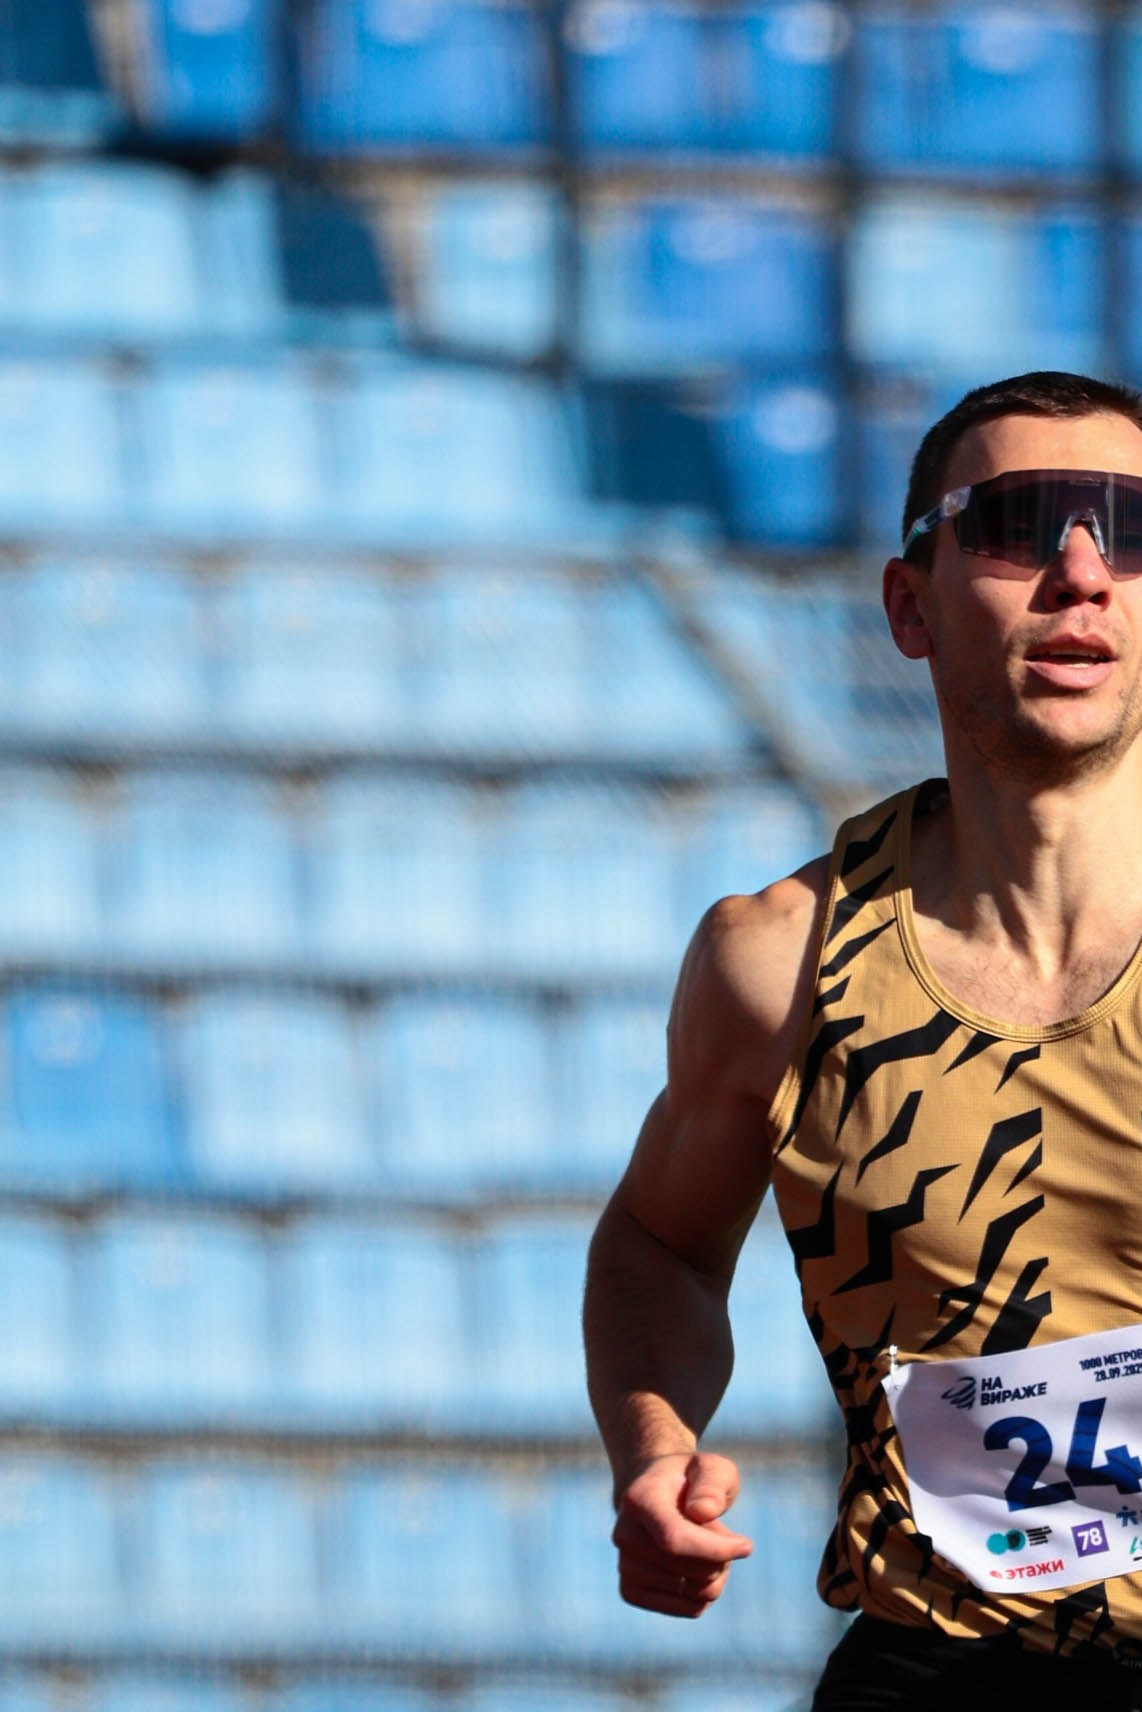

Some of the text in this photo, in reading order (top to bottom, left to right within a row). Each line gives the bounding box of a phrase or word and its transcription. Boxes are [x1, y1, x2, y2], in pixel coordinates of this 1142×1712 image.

[980, 1381, 1048, 1406] ВИРАЖЕ
[981, 1376, 1003, 1391] НА
[1077, 1527, 1103, 1551] 78
[1005, 1559, 1065, 1580] этажи
